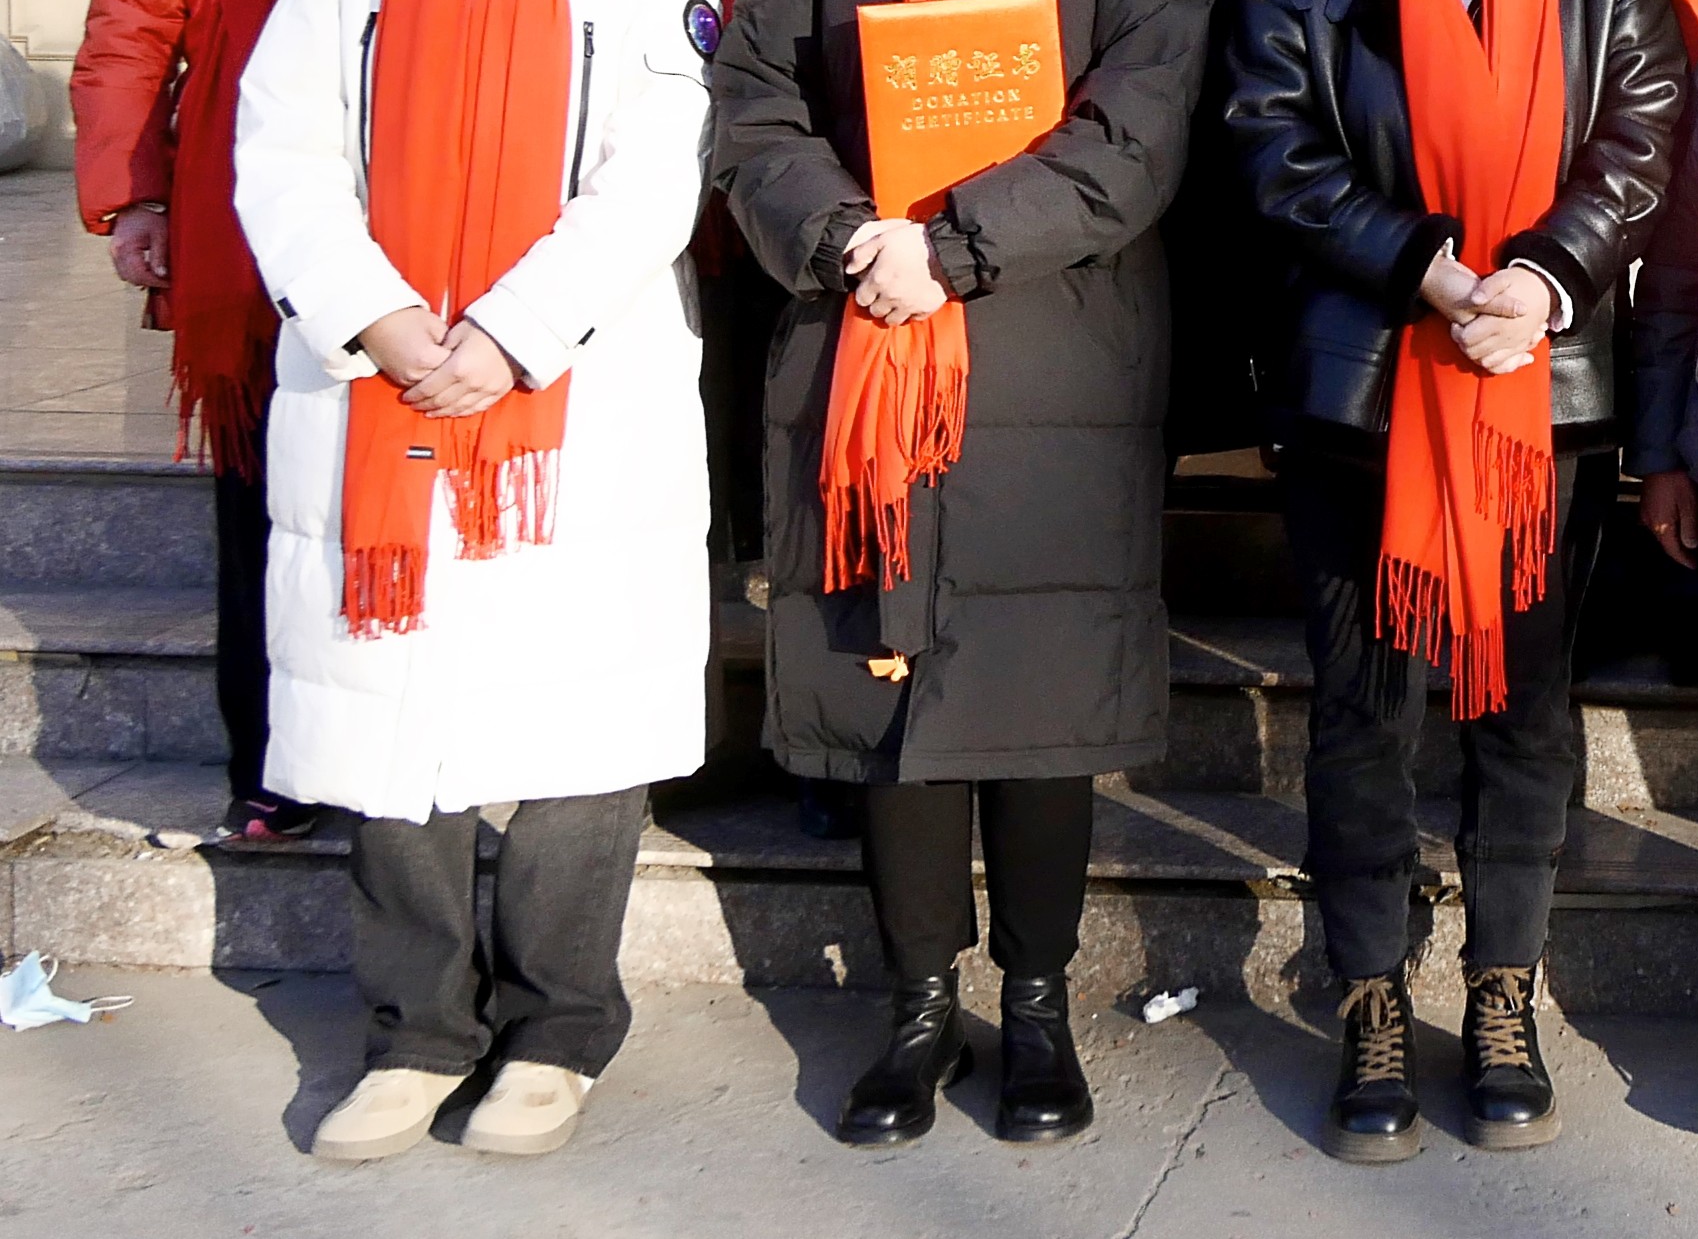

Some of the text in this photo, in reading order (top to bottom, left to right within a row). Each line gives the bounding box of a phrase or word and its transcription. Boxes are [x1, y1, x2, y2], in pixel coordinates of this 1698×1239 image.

[884, 43, 1042, 90] 捐赠证书
[912, 88, 1021, 111] DONATION
[901, 106, 1035, 131] CERTIFICATE
